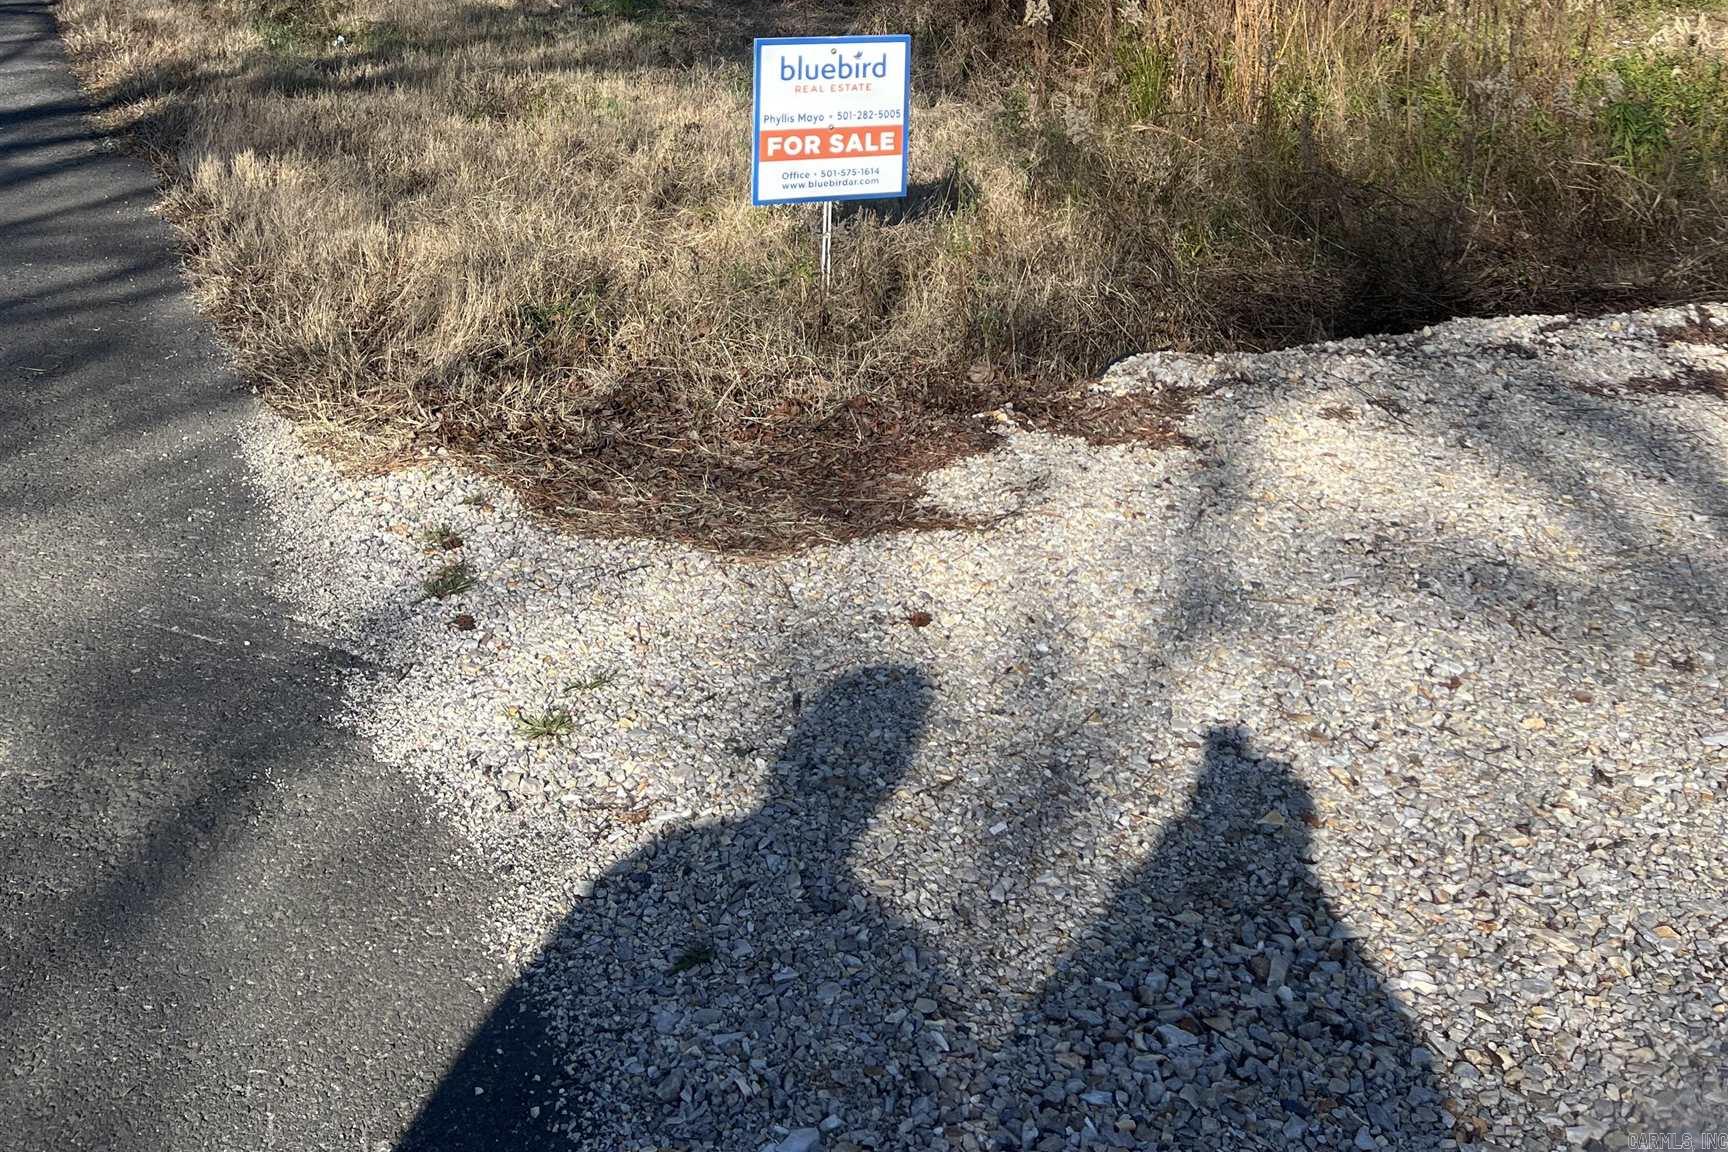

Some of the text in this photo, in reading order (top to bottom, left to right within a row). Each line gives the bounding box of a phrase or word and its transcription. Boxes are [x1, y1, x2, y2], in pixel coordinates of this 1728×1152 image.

[780, 52, 887, 81] bluebird
[794, 83, 873, 94] REAL ESTATE
[763, 109, 901, 126] Phyllis Mayo 501-282-5005
[767, 132, 895, 157] FOR SALE
[782, 167, 880, 180] Office 501-575-1614
[782, 178, 880, 190] www.bluebirdar.com
